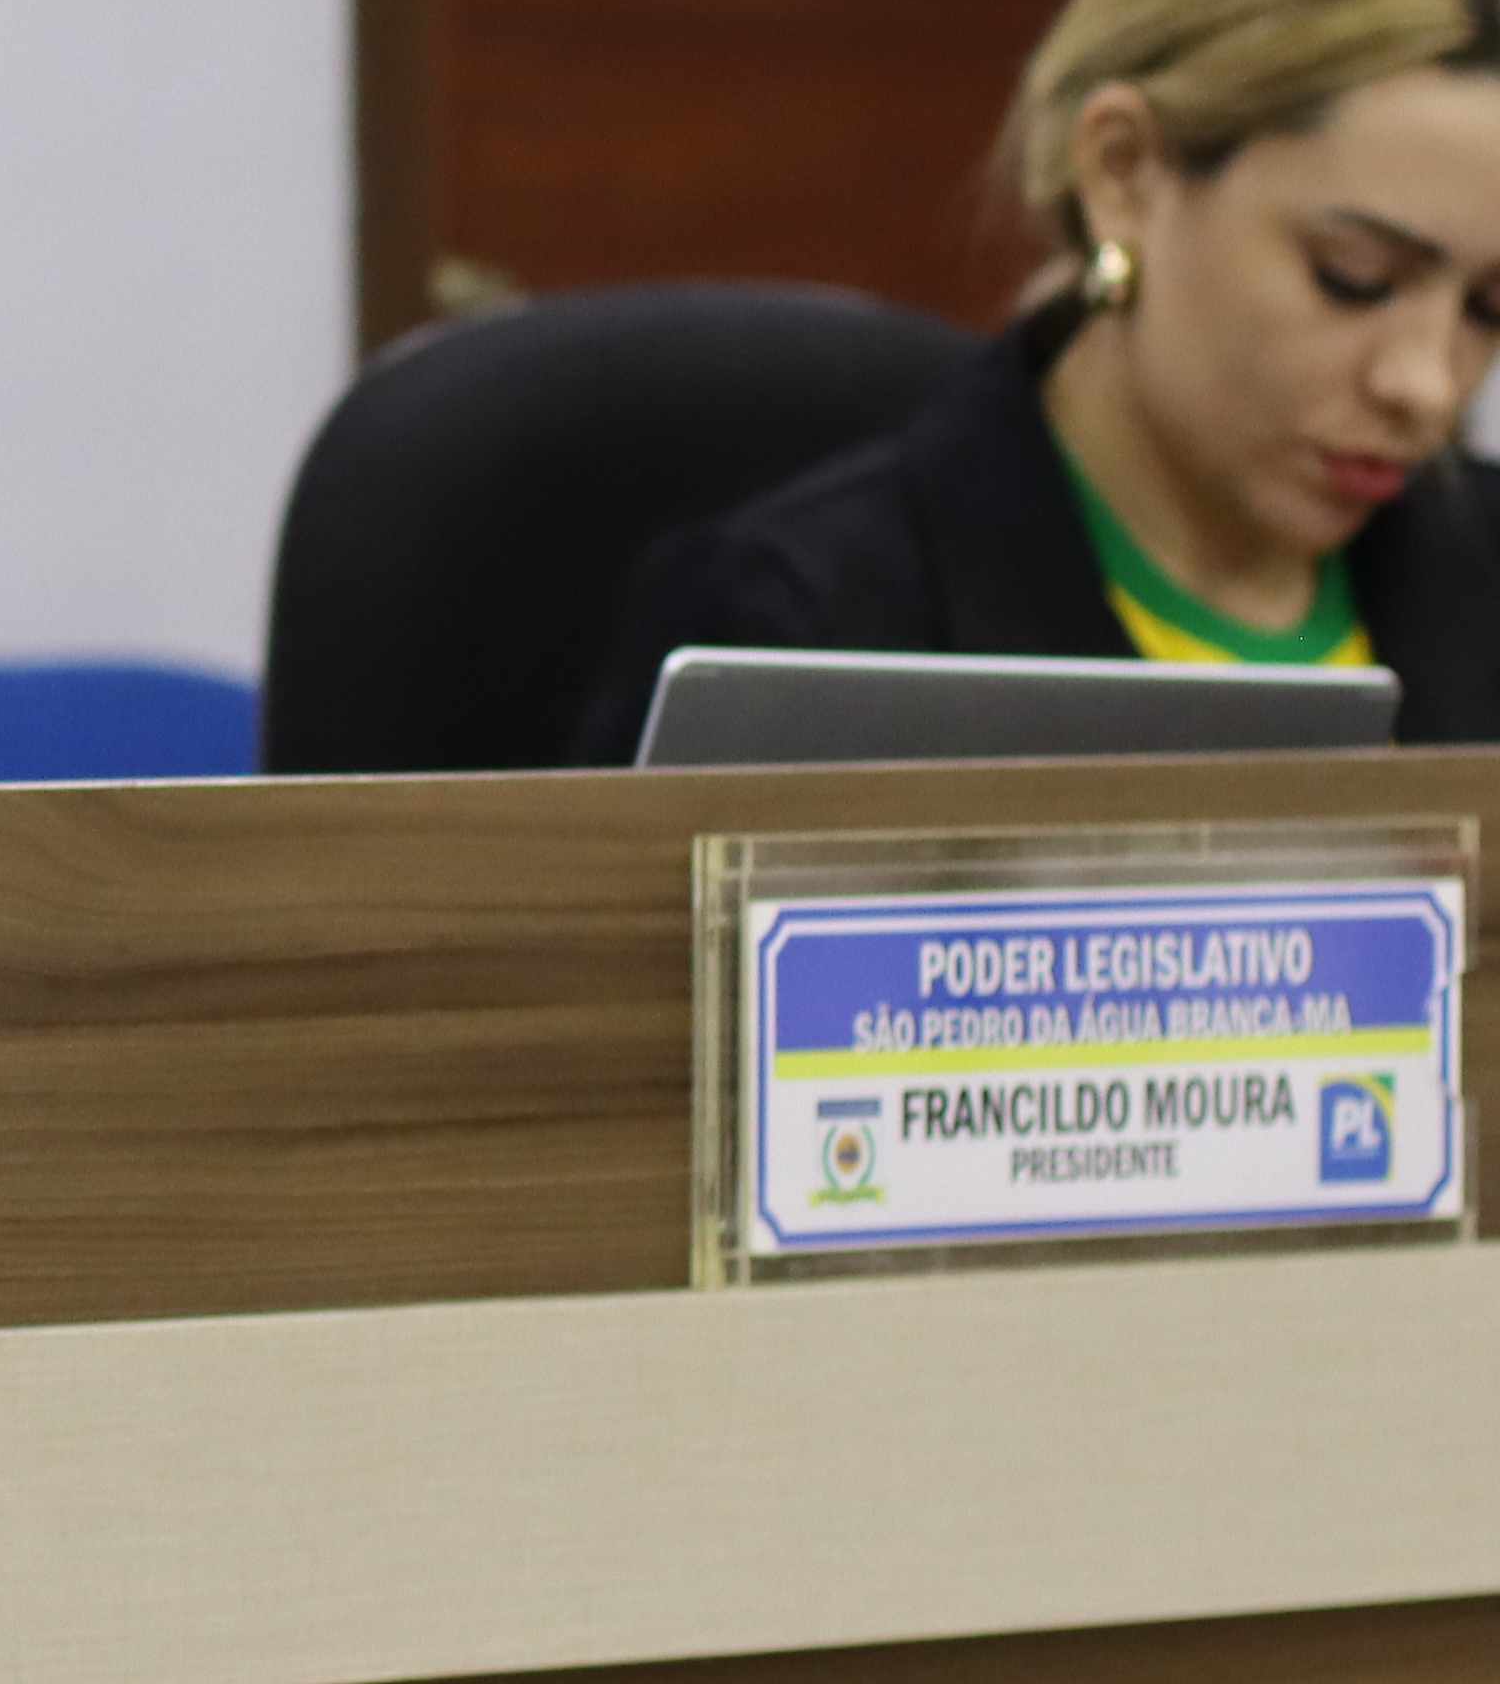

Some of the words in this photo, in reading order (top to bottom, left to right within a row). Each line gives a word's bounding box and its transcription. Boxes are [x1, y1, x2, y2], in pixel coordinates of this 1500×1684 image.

[918, 936, 1055, 998] PODER
[1064, 928, 1313, 993] LEGISLATIVO
[853, 1002, 916, 1054] SÃO
[923, 1005, 1025, 1051] PEDRO
[1030, 1003, 1073, 1048] DA
[1077, 994, 1164, 1045] ÁGUA
[901, 1080, 1130, 1142] FRANCILDO
[1144, 1073, 1297, 1130] MOURA
[1332, 1097, 1381, 1150] PL
[1010, 1140, 1180, 1184] PRESIDENTE
